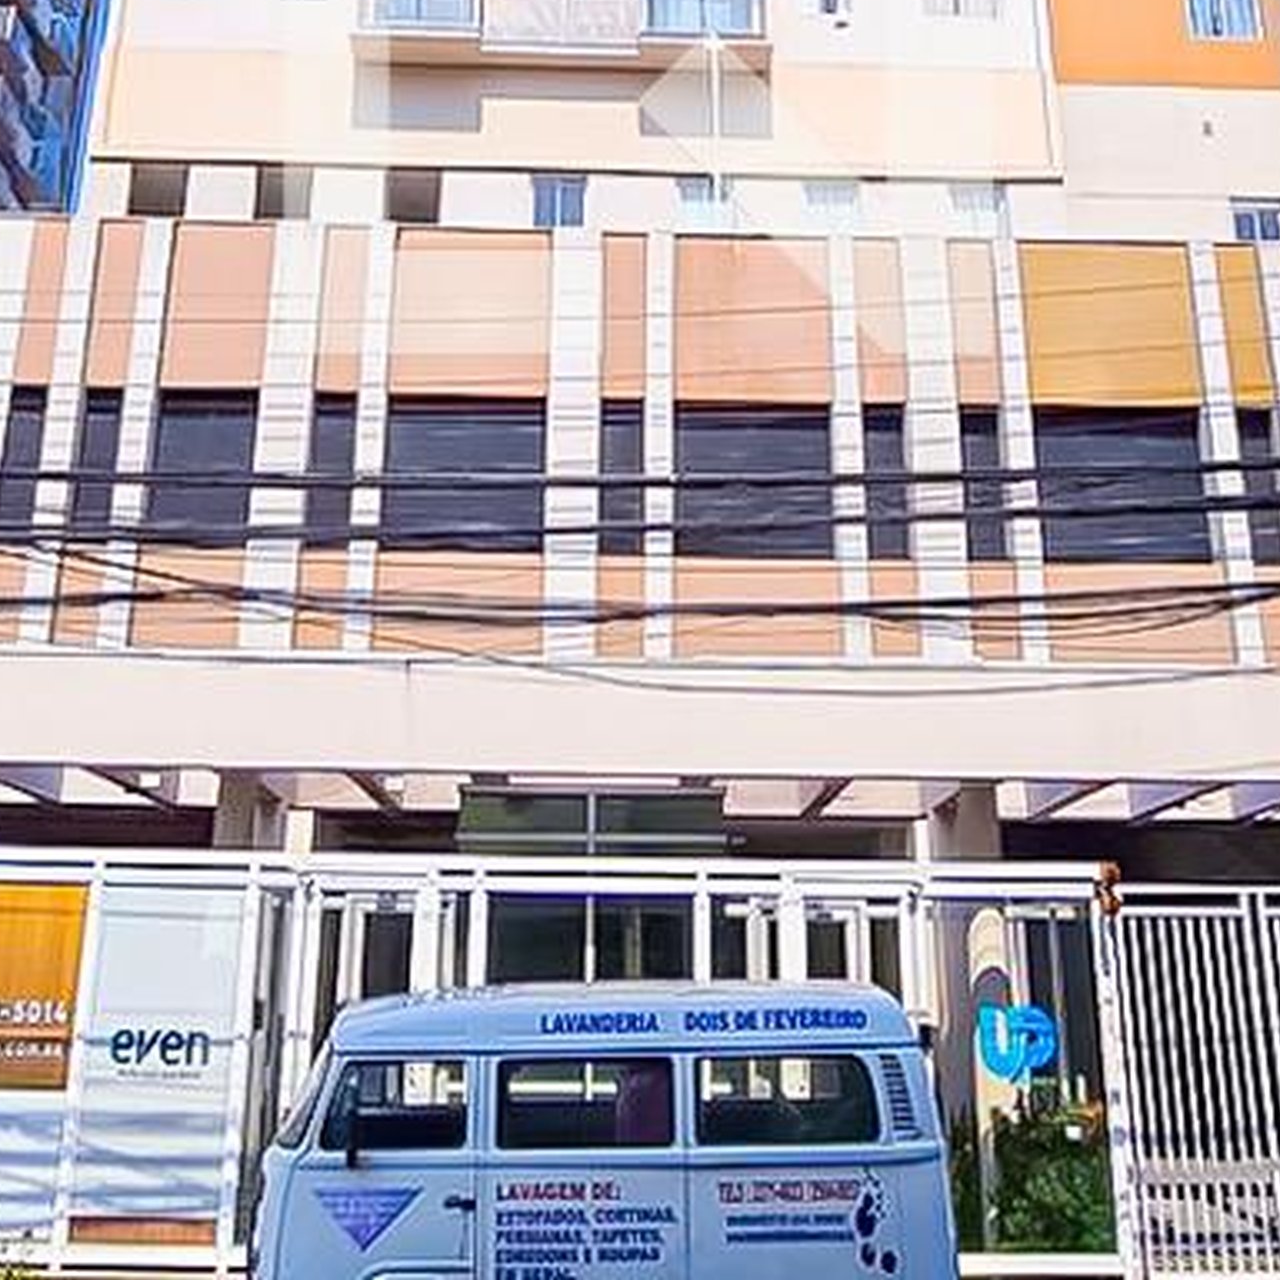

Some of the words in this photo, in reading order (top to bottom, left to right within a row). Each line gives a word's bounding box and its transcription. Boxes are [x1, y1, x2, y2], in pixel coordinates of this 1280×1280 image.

[540, 1011, 660, 1035] LAVANDERIA
[684, 1011, 730, 1033] DOIS
[733, 1010, 759, 1031] DE
[764, 1008, 868, 1030] FEVEREIRO
[111, 1029, 209, 1066] even
[496, 1183, 586, 1201] LAVAGEM
